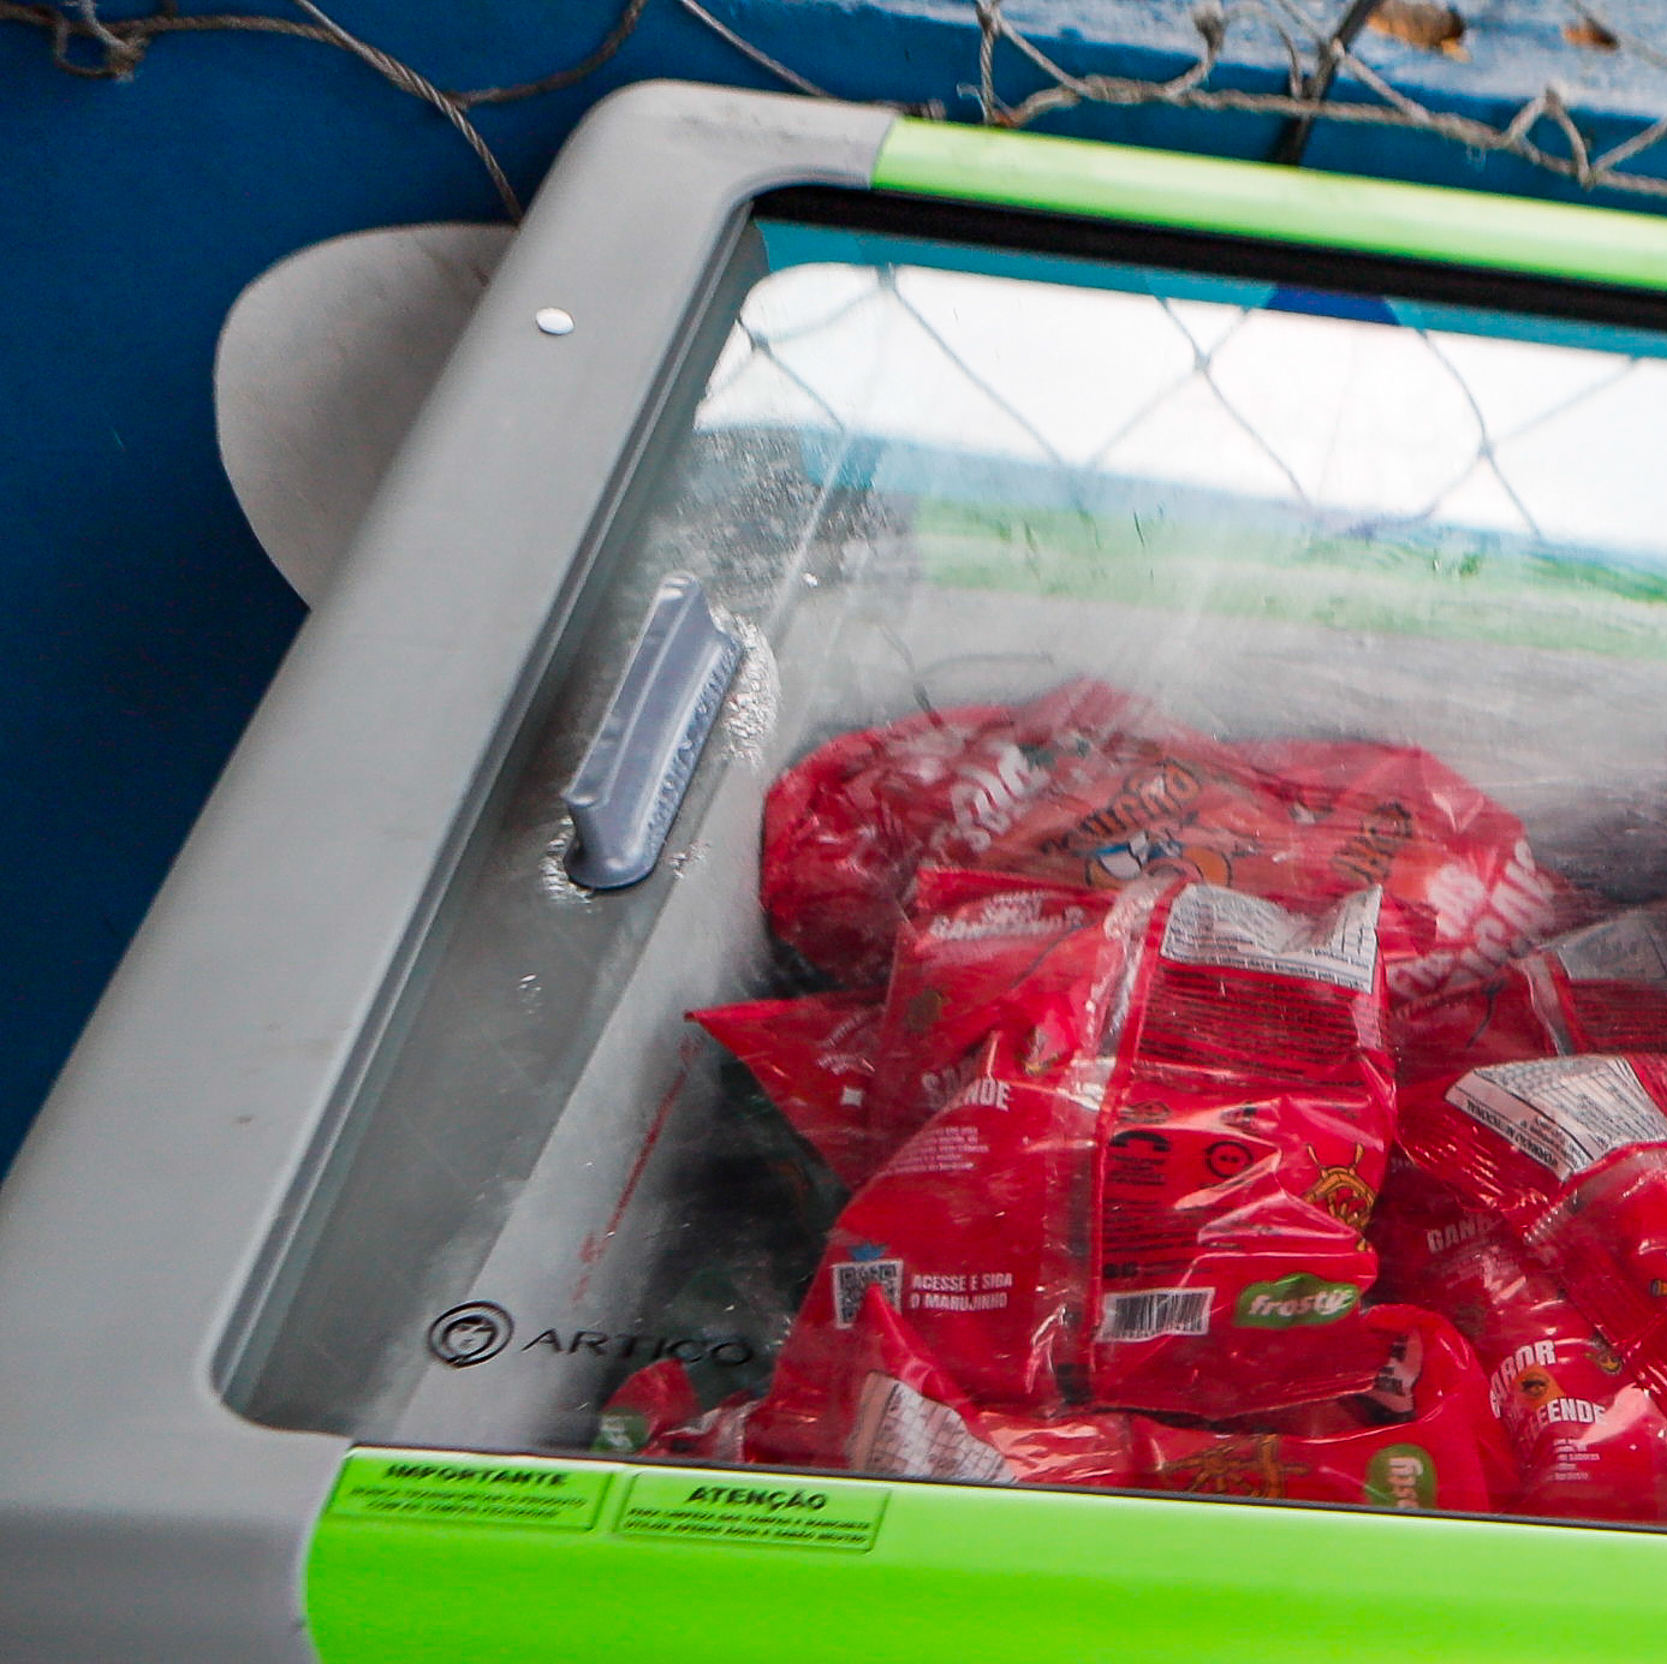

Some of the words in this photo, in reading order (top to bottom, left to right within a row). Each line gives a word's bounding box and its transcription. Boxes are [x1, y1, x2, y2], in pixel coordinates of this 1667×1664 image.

[1249, 1288, 1358, 1318] frosty
[522, 1326, 754, 1367] ARTICO
[686, 1484, 828, 1512] ATENÇÃO
